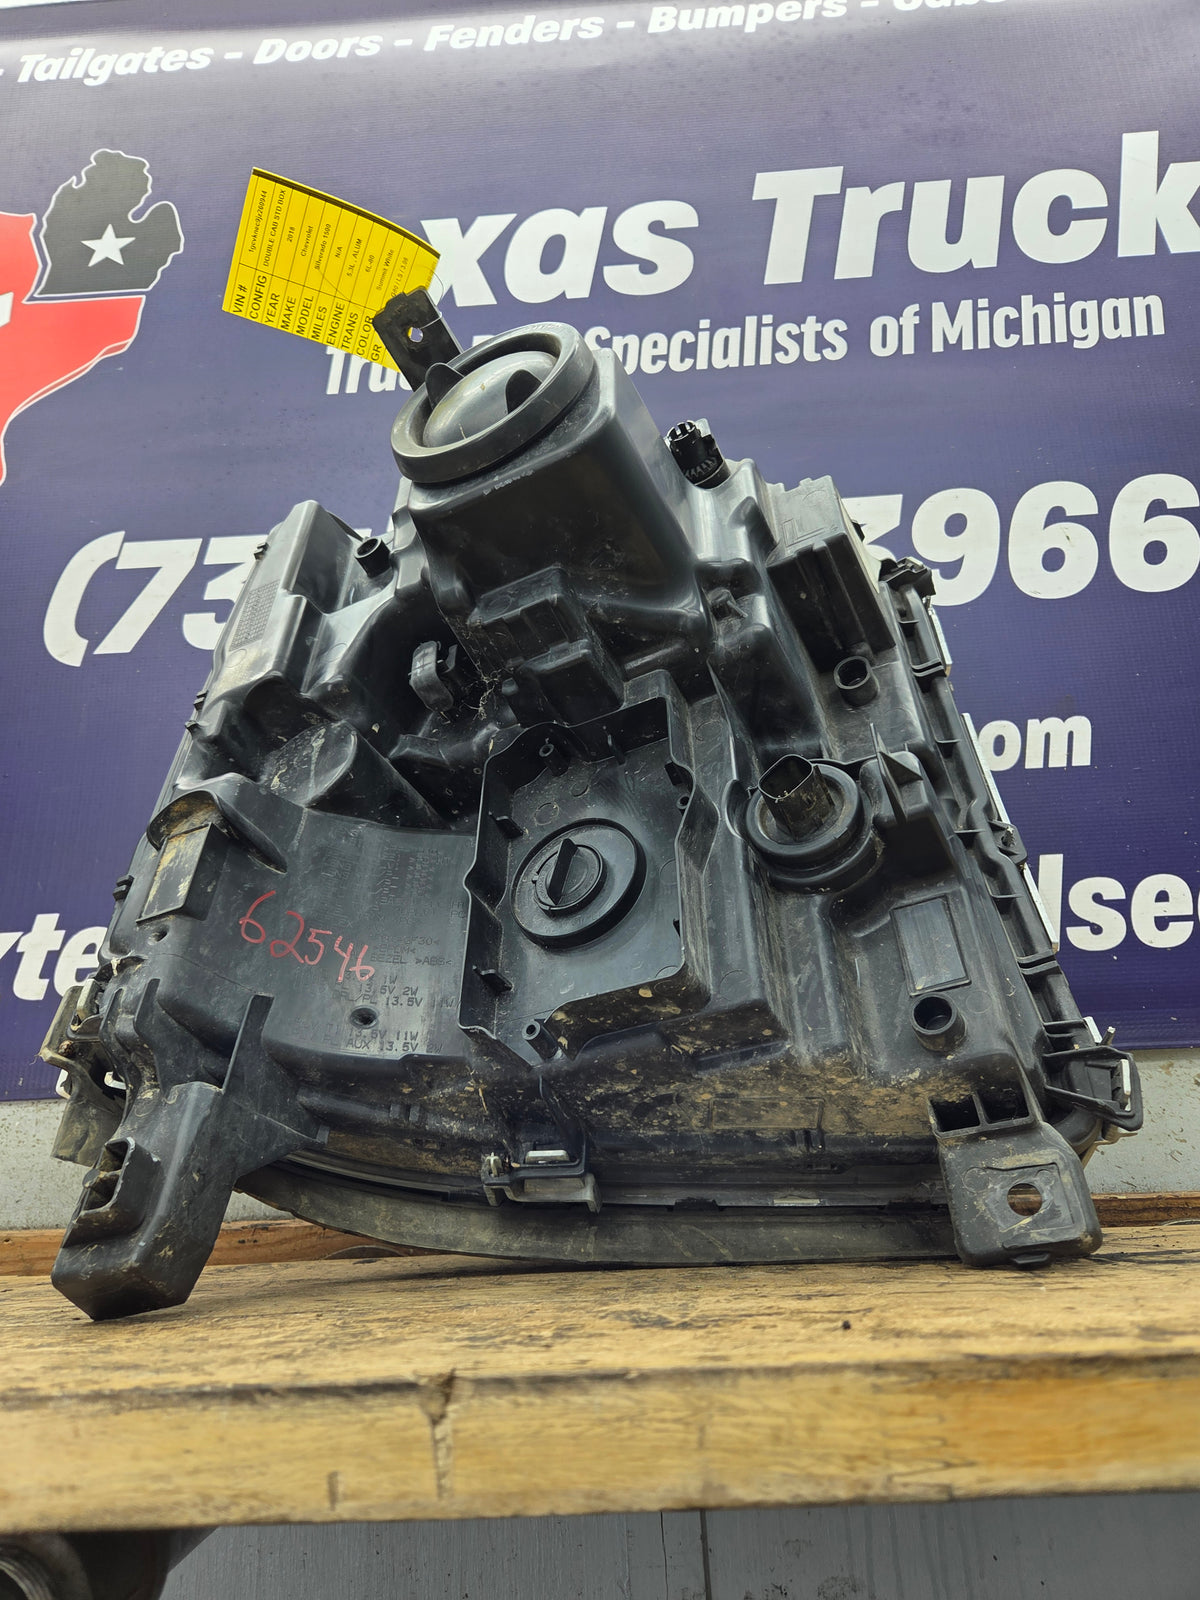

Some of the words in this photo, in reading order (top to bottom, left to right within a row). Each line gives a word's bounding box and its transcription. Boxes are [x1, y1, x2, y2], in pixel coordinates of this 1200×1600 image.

[17, 47, 214, 86] Tailgates
[253, 34, 382, 64] Doors
[424, 13, 604, 52] Fenders
[647, 0, 848, 33] Bumpers
[420, 200, 699, 307] xas
[752, 130, 1200, 285] Truck
[248, 274, 267, 319] CONFIG
[280, 295, 296, 329] MAKE
[300, 225, 313, 257] Chevrolet
[232, 293, 245, 314] VIN
[264, 292, 280, 324] YEAR
[295, 293, 313, 334] MODEL
[310, 305, 327, 340] MILES
[326, 301, 345, 345] ENGINE
[326, 347, 412, 395] Tru
[869, 304, 920, 355] of
[931, 292, 1165, 352] Michigan
[340, 311, 358, 350] TRANS
[355, 315, 373, 356] COLOR
[370, 343, 382, 361] GR
[43, 531, 275, 666] (73
[977, 716, 1092, 771] om
[240, 891, 375, 982] 62546
